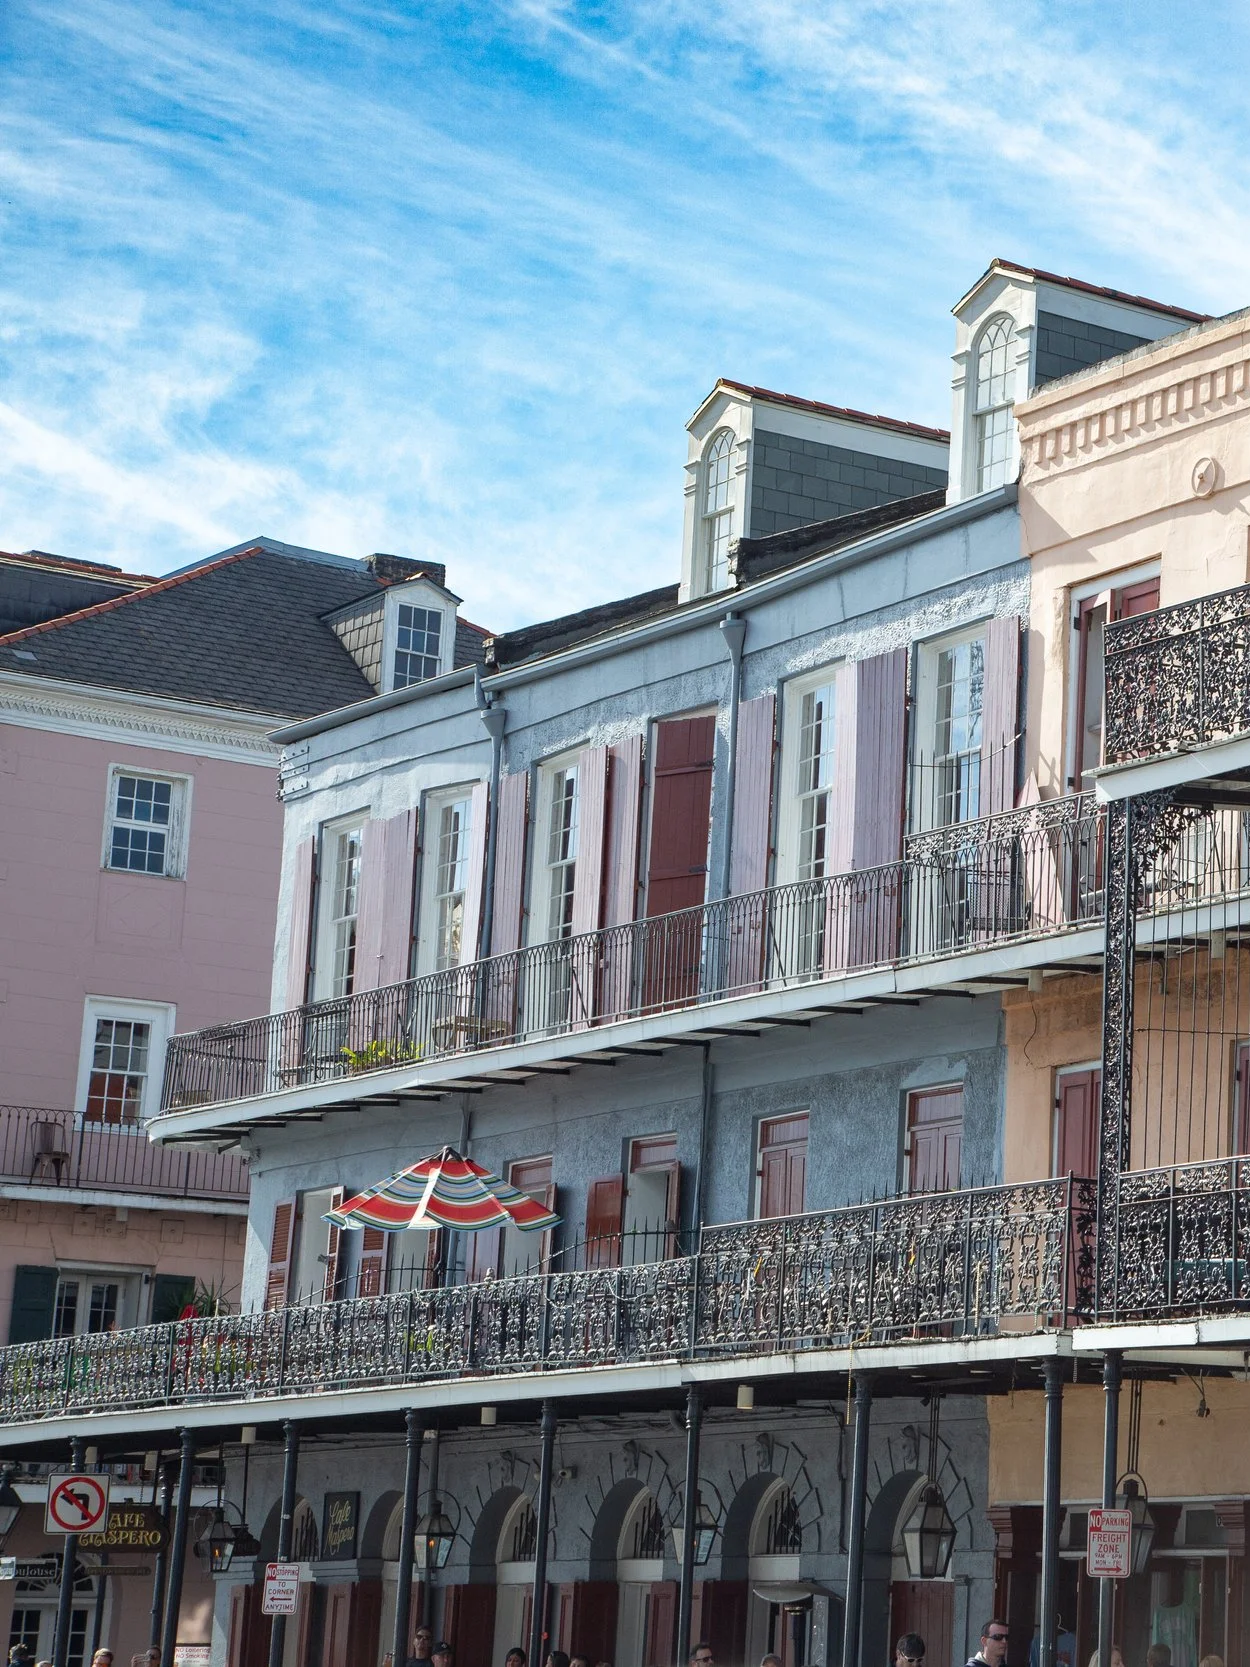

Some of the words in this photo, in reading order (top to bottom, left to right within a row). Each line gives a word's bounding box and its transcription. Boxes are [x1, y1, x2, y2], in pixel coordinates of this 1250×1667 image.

[109, 1513, 146, 1530] AFE
[1090, 1514, 1101, 1528] NO
[1101, 1517, 1129, 1527] PARKING
[1092, 1533, 1127, 1543] FREIGHT
[1097, 1543, 1120, 1553] ZONE
[15, 1565, 56, 1577] oulouse
[267, 1567, 277, 1577] NO
[265, 1603, 295, 1611] ANYTIME
